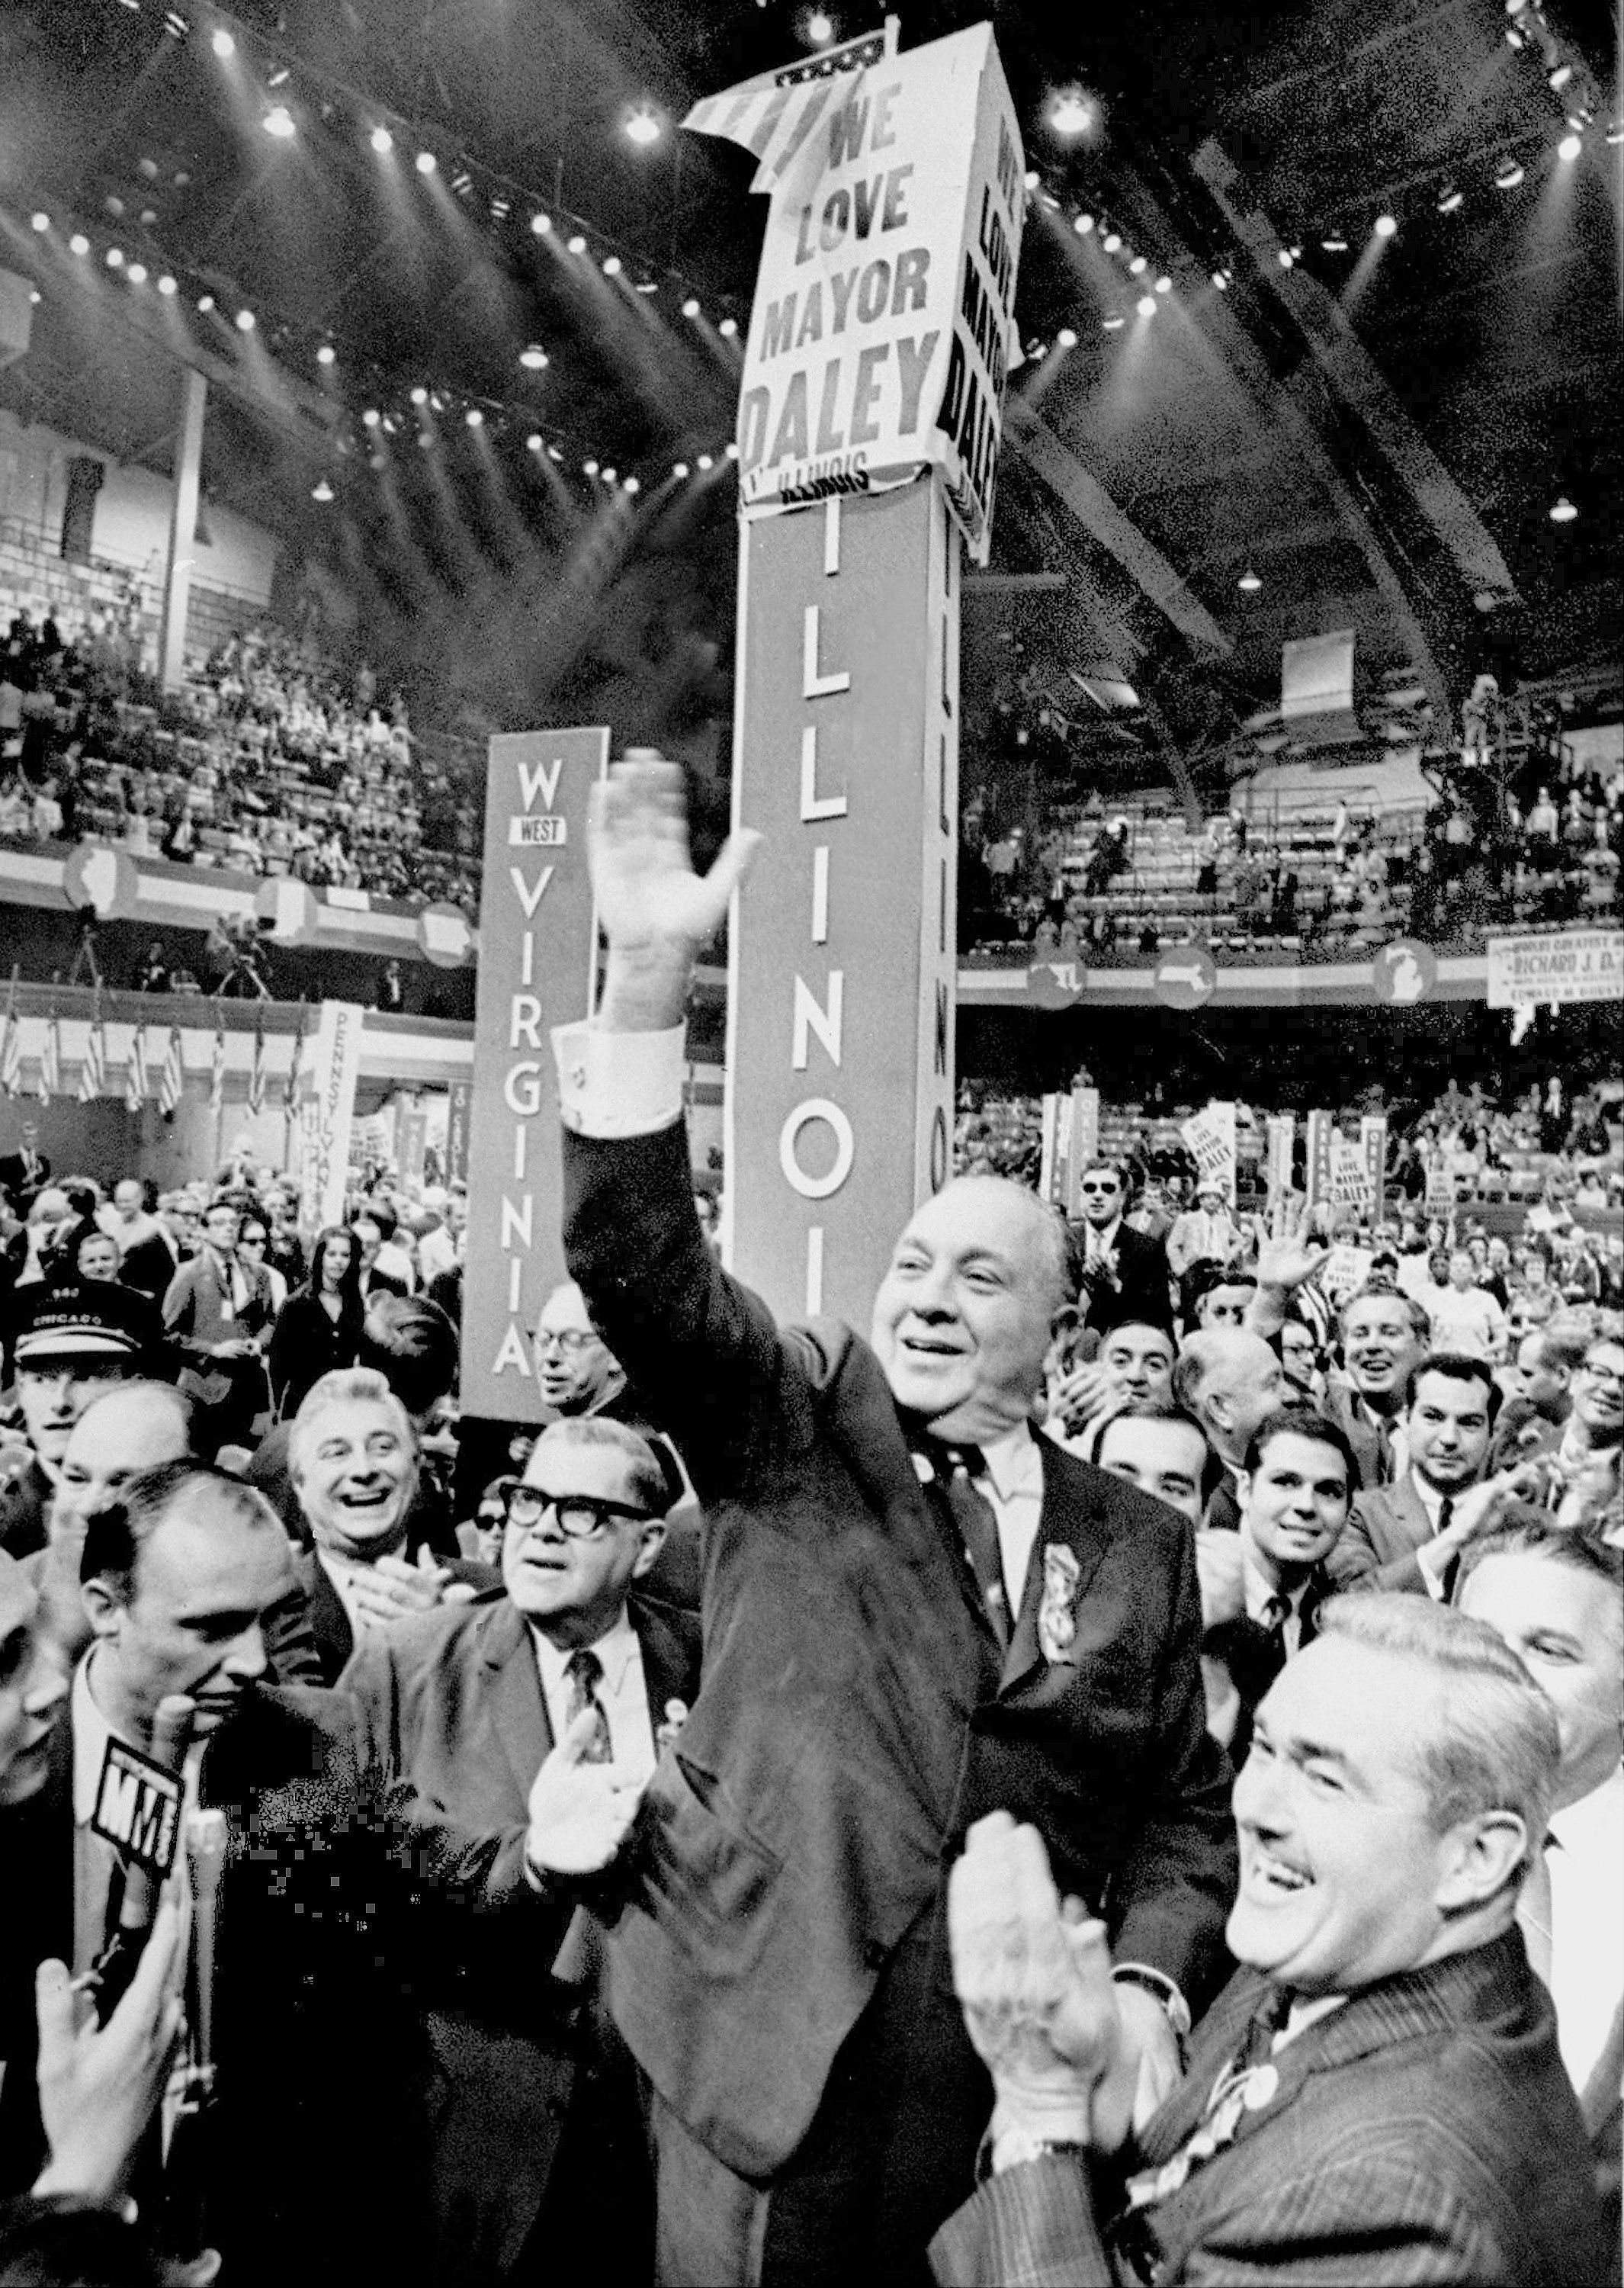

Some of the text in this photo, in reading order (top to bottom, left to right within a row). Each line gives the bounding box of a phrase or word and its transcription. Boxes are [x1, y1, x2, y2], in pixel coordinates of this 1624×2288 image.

[828, 83, 902, 171] WE
[795, 163, 914, 266] LOVE
[760, 247, 932, 363] MAYOR
[744, 330, 942, 471] DALEY
[937, 329, 995, 515] DALE
[777, 450, 870, 504] ILLINOIS
[520, 818, 560, 842] WEST
[780, 498, 855, 1318] ILLINOI
[313, 1011, 348, 1220] PENNSYLVAN
[492, 759, 563, 1377] W VIRGINIA
[1335, 1174, 1365, 1184] MAYOR
[1335, 1186, 1370, 1203] DALEY
[33, 1313, 102, 1327] CHICAGO
